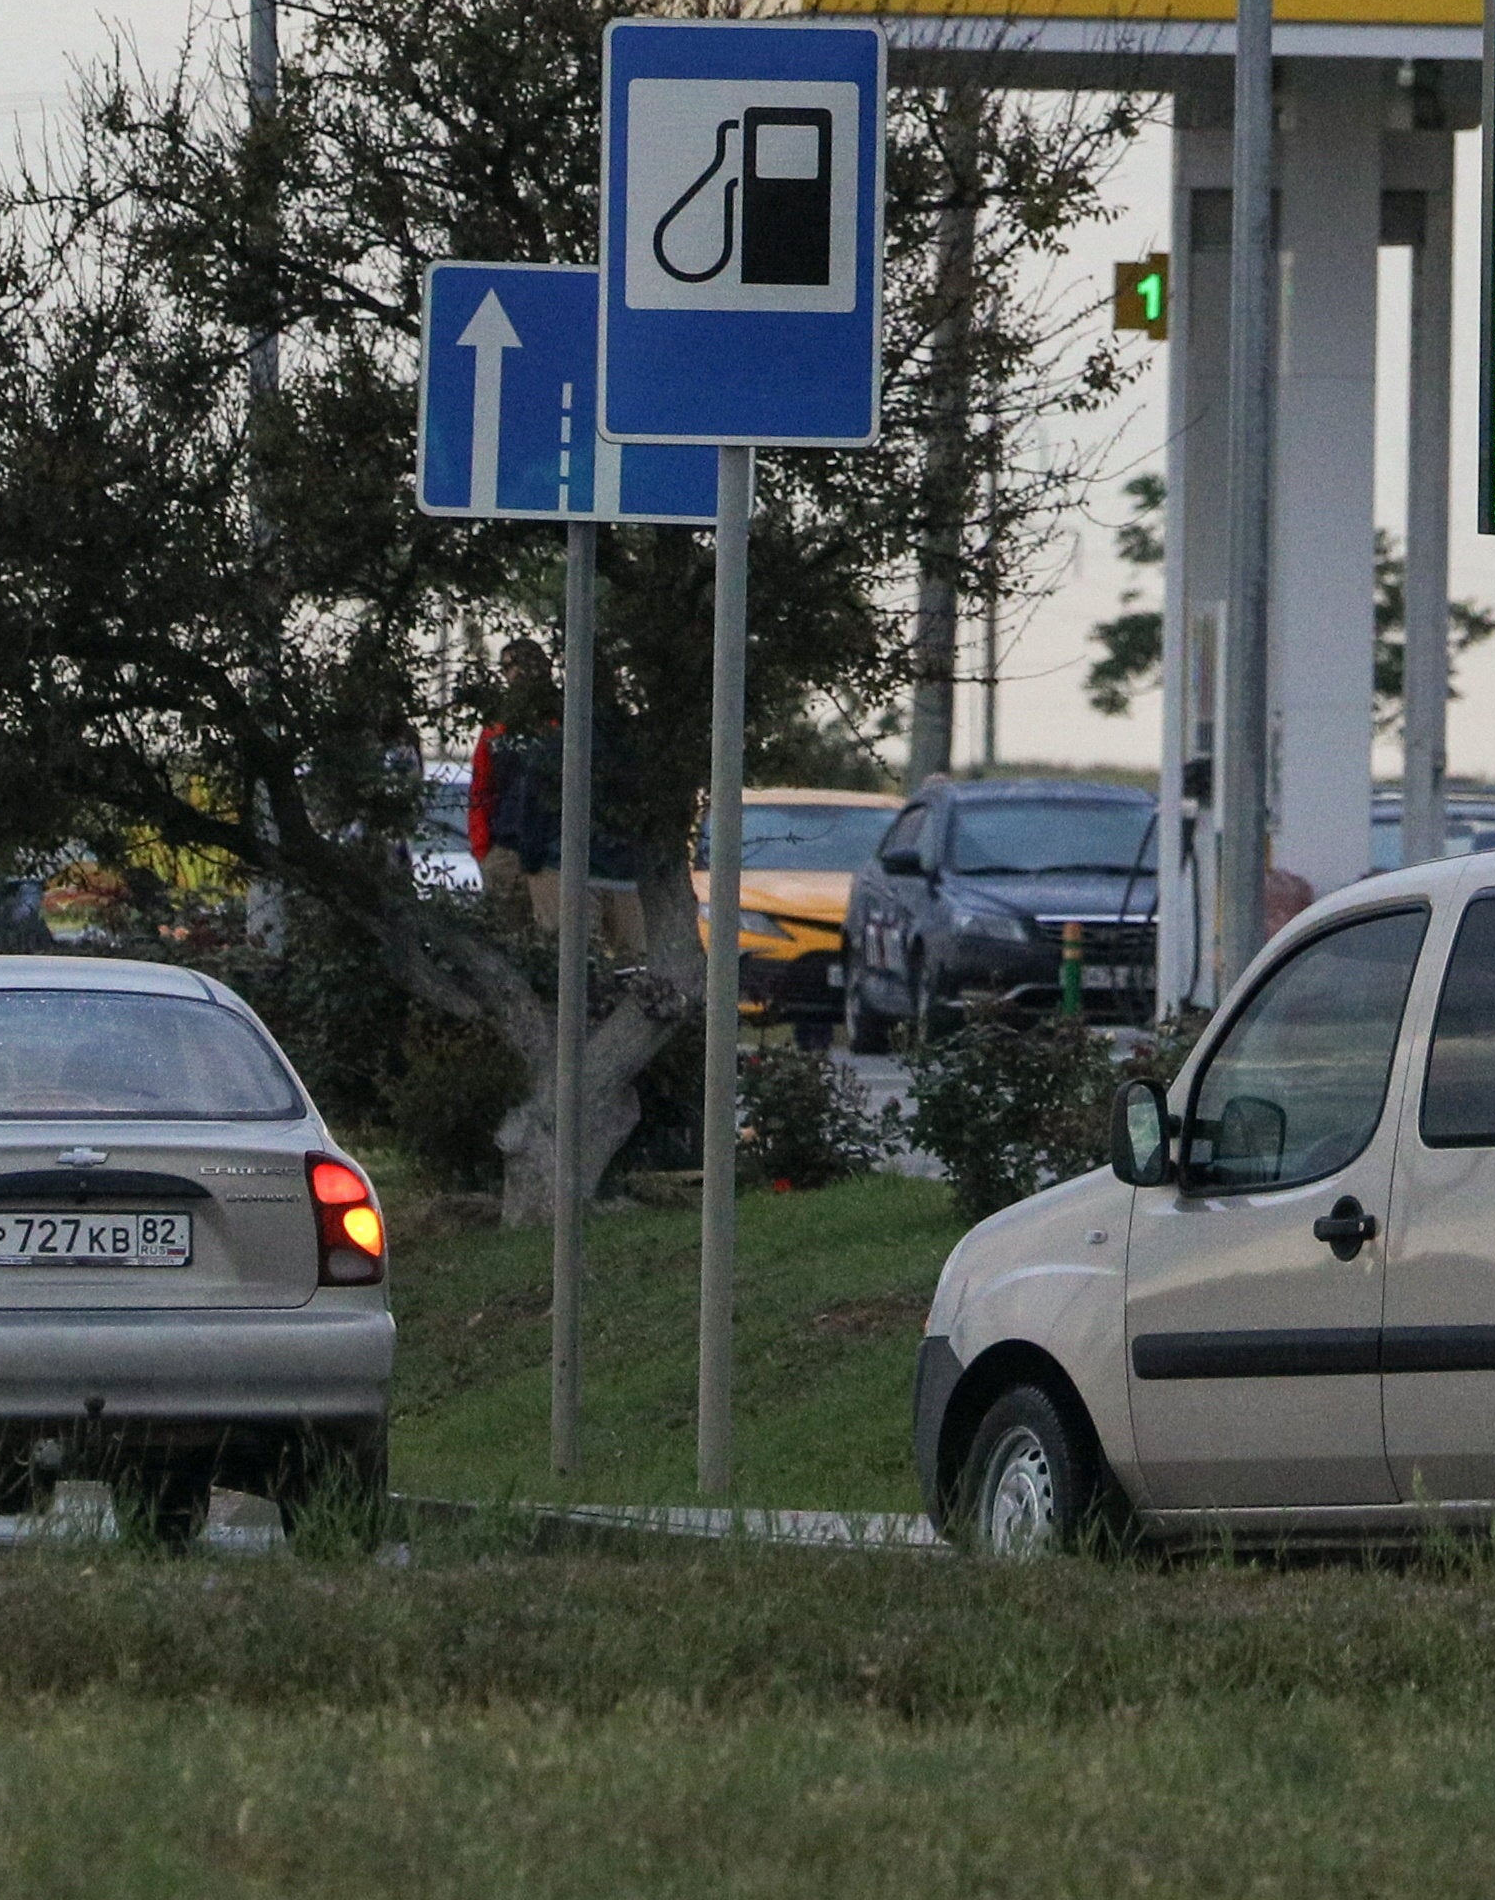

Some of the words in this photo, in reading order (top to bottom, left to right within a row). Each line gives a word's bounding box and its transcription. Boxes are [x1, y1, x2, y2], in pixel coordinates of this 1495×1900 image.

[1136, 272, 1161, 320] 1
[142, 1218, 176, 1245] 82
[140, 1245, 167, 1256] RUS
